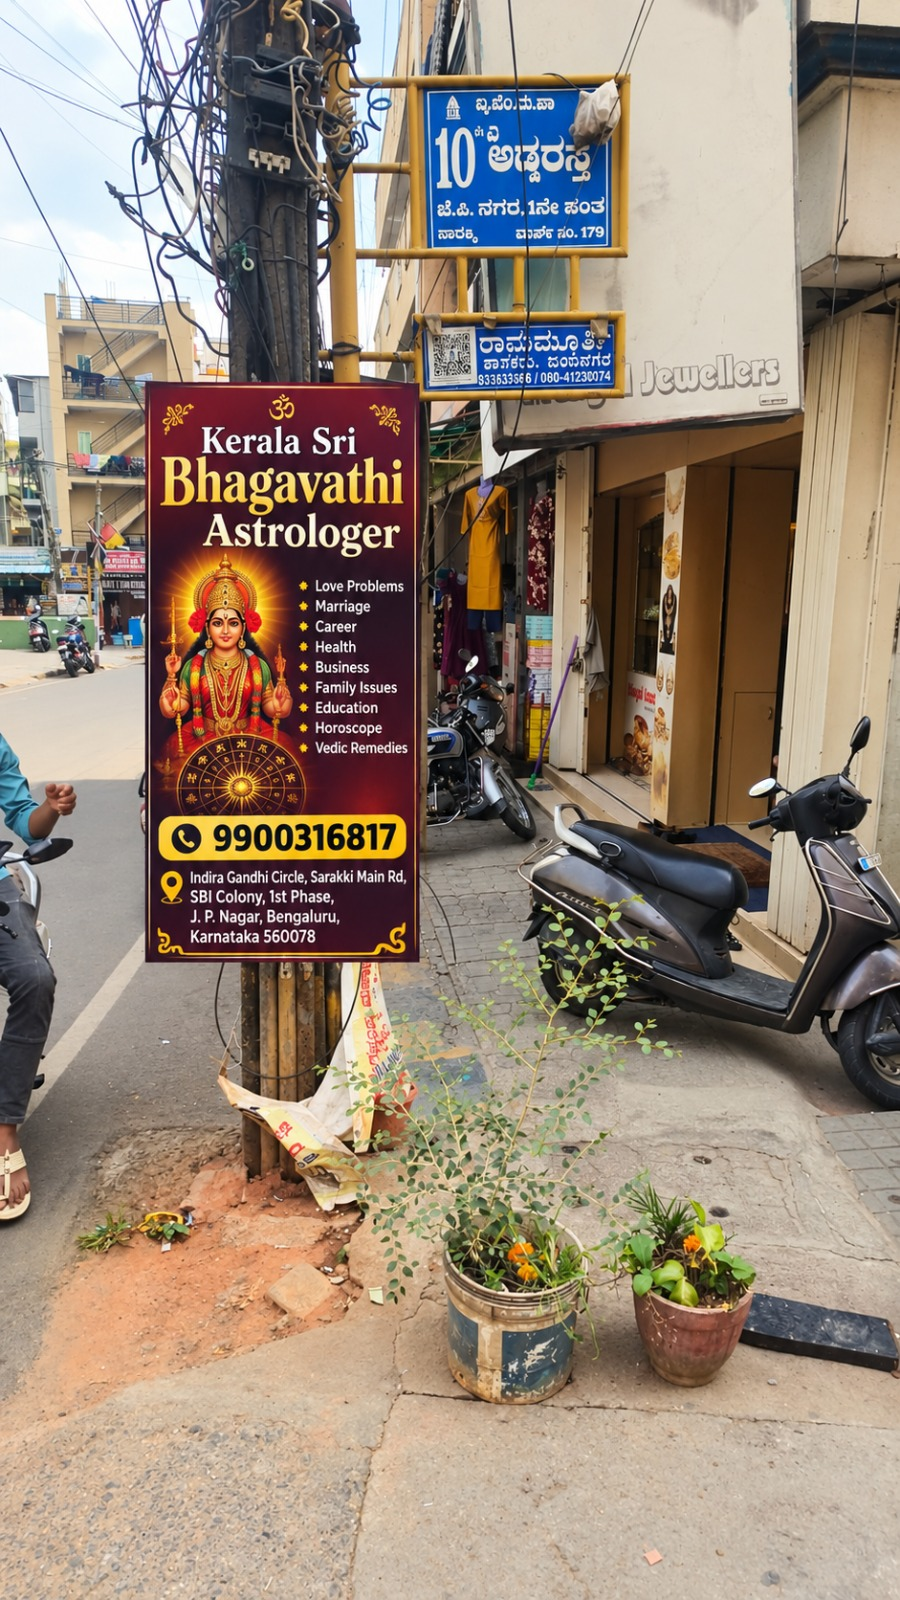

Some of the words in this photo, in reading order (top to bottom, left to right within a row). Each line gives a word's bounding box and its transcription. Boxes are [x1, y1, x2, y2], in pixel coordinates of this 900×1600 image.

[581, 226, 605, 239] 179
[640, 353, 780, 397] Jewellers
[201, 425, 301, 455] Kerala
[312, 426, 357, 455] Sri
[160, 456, 404, 516] Bhagavathi
[202, 512, 401, 558] Astrologer
[315, 580, 344, 593] Love
[347, 580, 404, 593] Problems
[315, 600, 371, 615] Marriage
[315, 620, 357, 633] Career
[315, 640, 356, 653] Health
[315, 661, 370, 673] Business
[315, 681, 356, 696] Family
[360, 681, 398, 694] Issues
[315, 701, 379, 714] Education
[315, 721, 383, 736] Horoscope
[315, 741, 348, 754] Vedic
[351, 741, 408, 754] Remedies
[213, 823, 397, 852] 9900316817
[190, 871, 224, 884] Indira
[226, 871, 268, 884] Gandhi
[271, 870, 308, 885] Circle,
[310, 870, 354, 884] Sarakki
[357, 870, 385, 883] Main
[387, 870, 407, 885] Rd,
[190, 890, 212, 904] SBI
[216, 889, 266, 906] Colony,
[269, 889, 287, 903] 1st
[291, 889, 335, 905] Phase,
[190, 910, 201, 923] J.
[204, 910, 216, 923] P.
[219, 910, 263, 926] Nagar,
[267, 909, 340, 926] Bengaluru,
[190, 929, 260, 943] Karnataka
[263, 929, 316, 943] 560078
